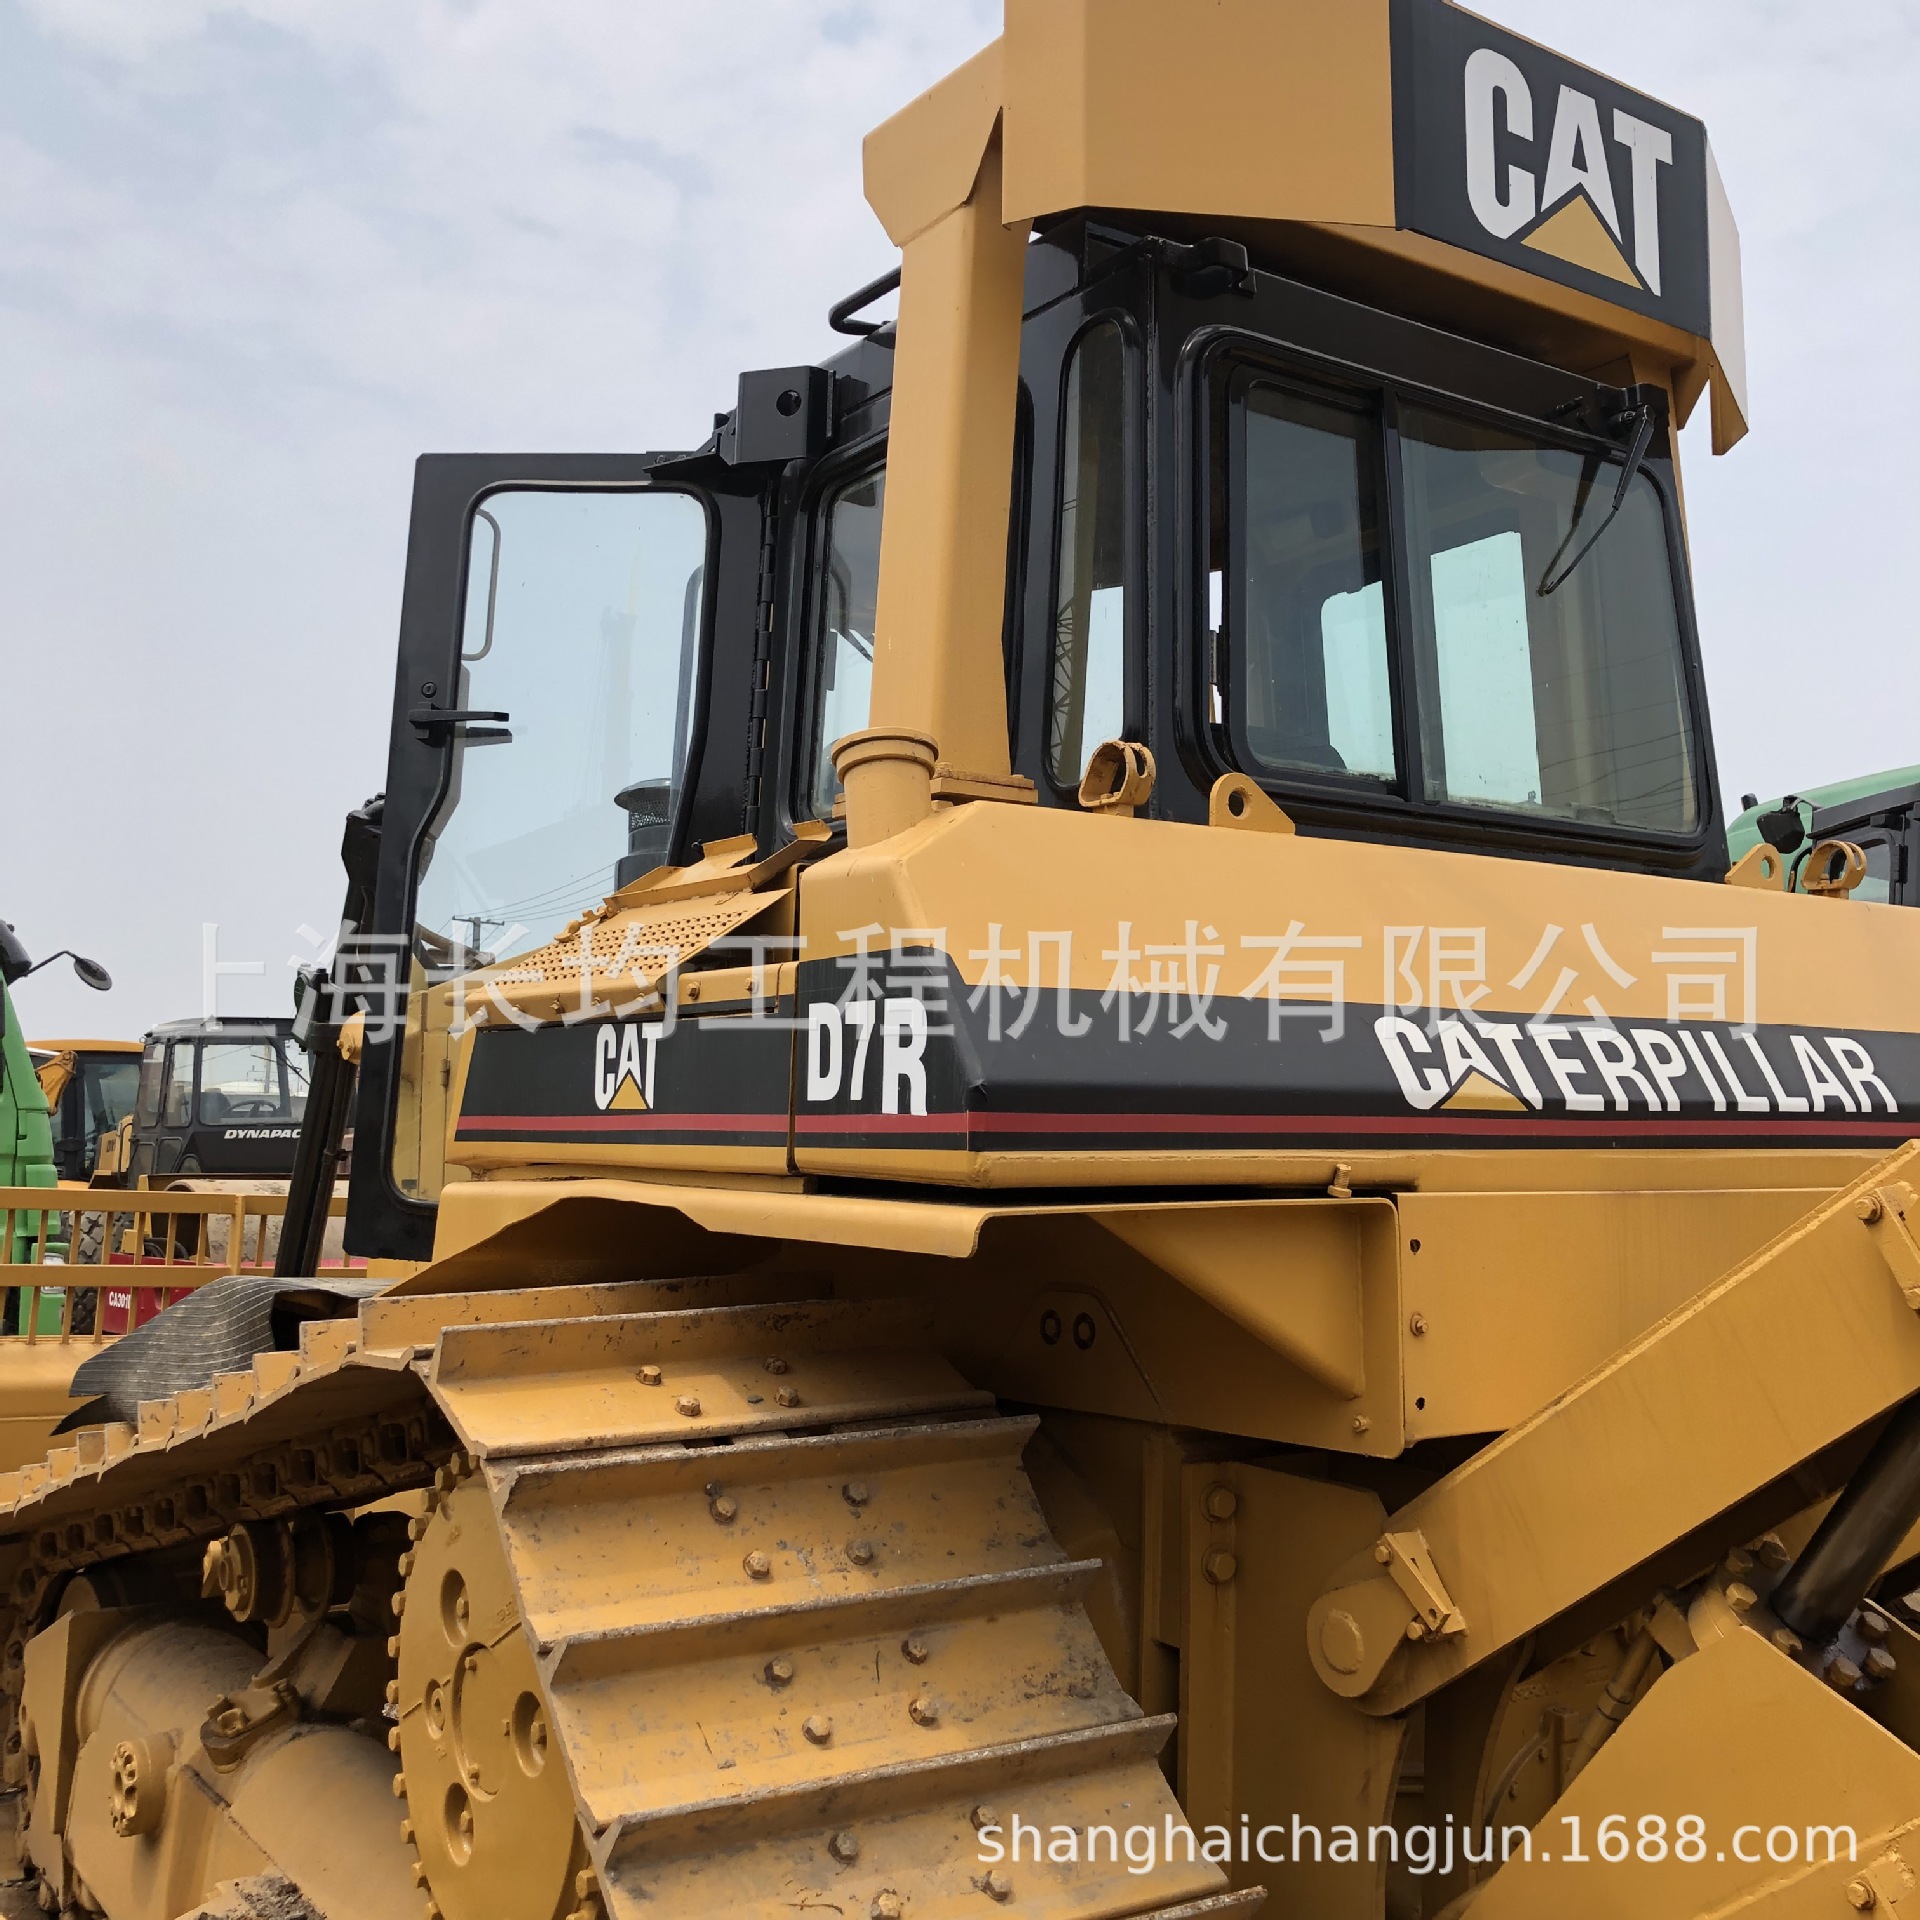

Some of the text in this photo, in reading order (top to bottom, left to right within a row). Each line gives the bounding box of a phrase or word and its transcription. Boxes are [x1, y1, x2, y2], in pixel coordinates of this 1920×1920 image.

[1464, 48, 1673, 297] CAT
[594, 1023, 663, 1111] CAT
[806, 997, 928, 1117] D7R
[1373, 1015, 1900, 1114] CATERPILLAR
[223, 1129, 302, 1140] DYNAPAC
